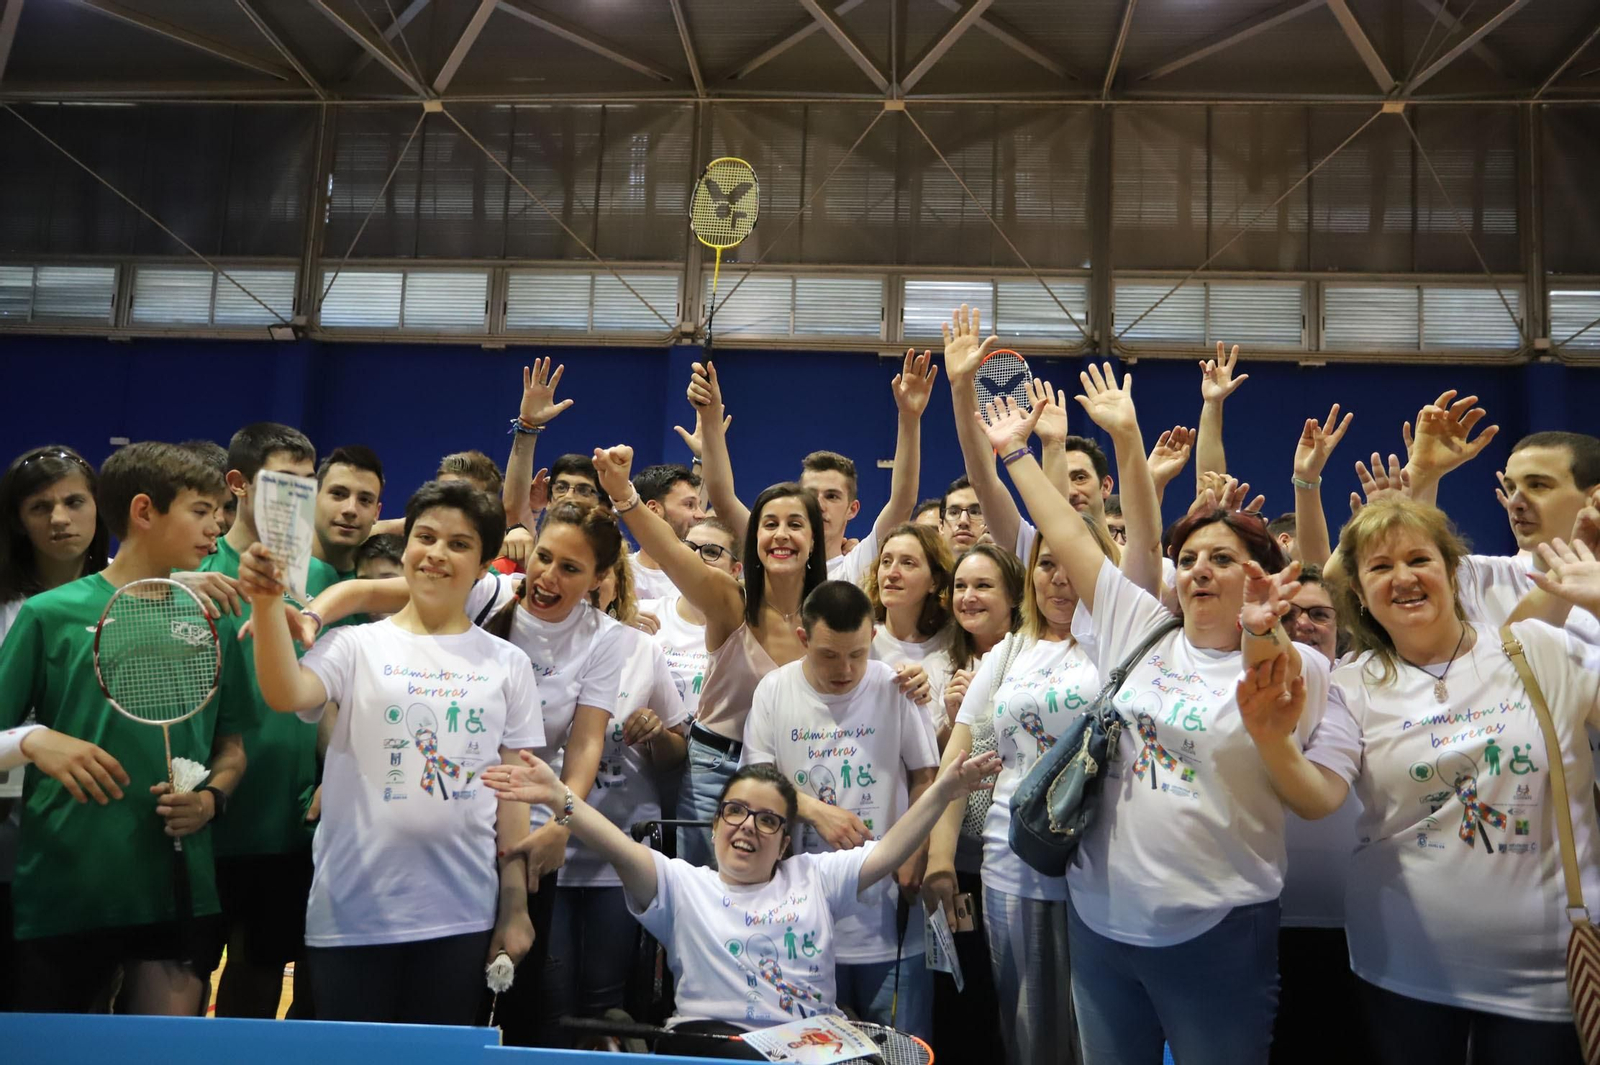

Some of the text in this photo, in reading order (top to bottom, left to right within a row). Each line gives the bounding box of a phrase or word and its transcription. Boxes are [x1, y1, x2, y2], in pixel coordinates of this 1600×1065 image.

[383, 664, 489, 682] Bádminton sin
[408, 681, 468, 698] barreras
[1499, 698, 1527, 714] sin
[791, 724, 876, 742] Bádminton sin
[1431, 723, 1505, 748] barreras
[808, 745, 857, 760] barreras
